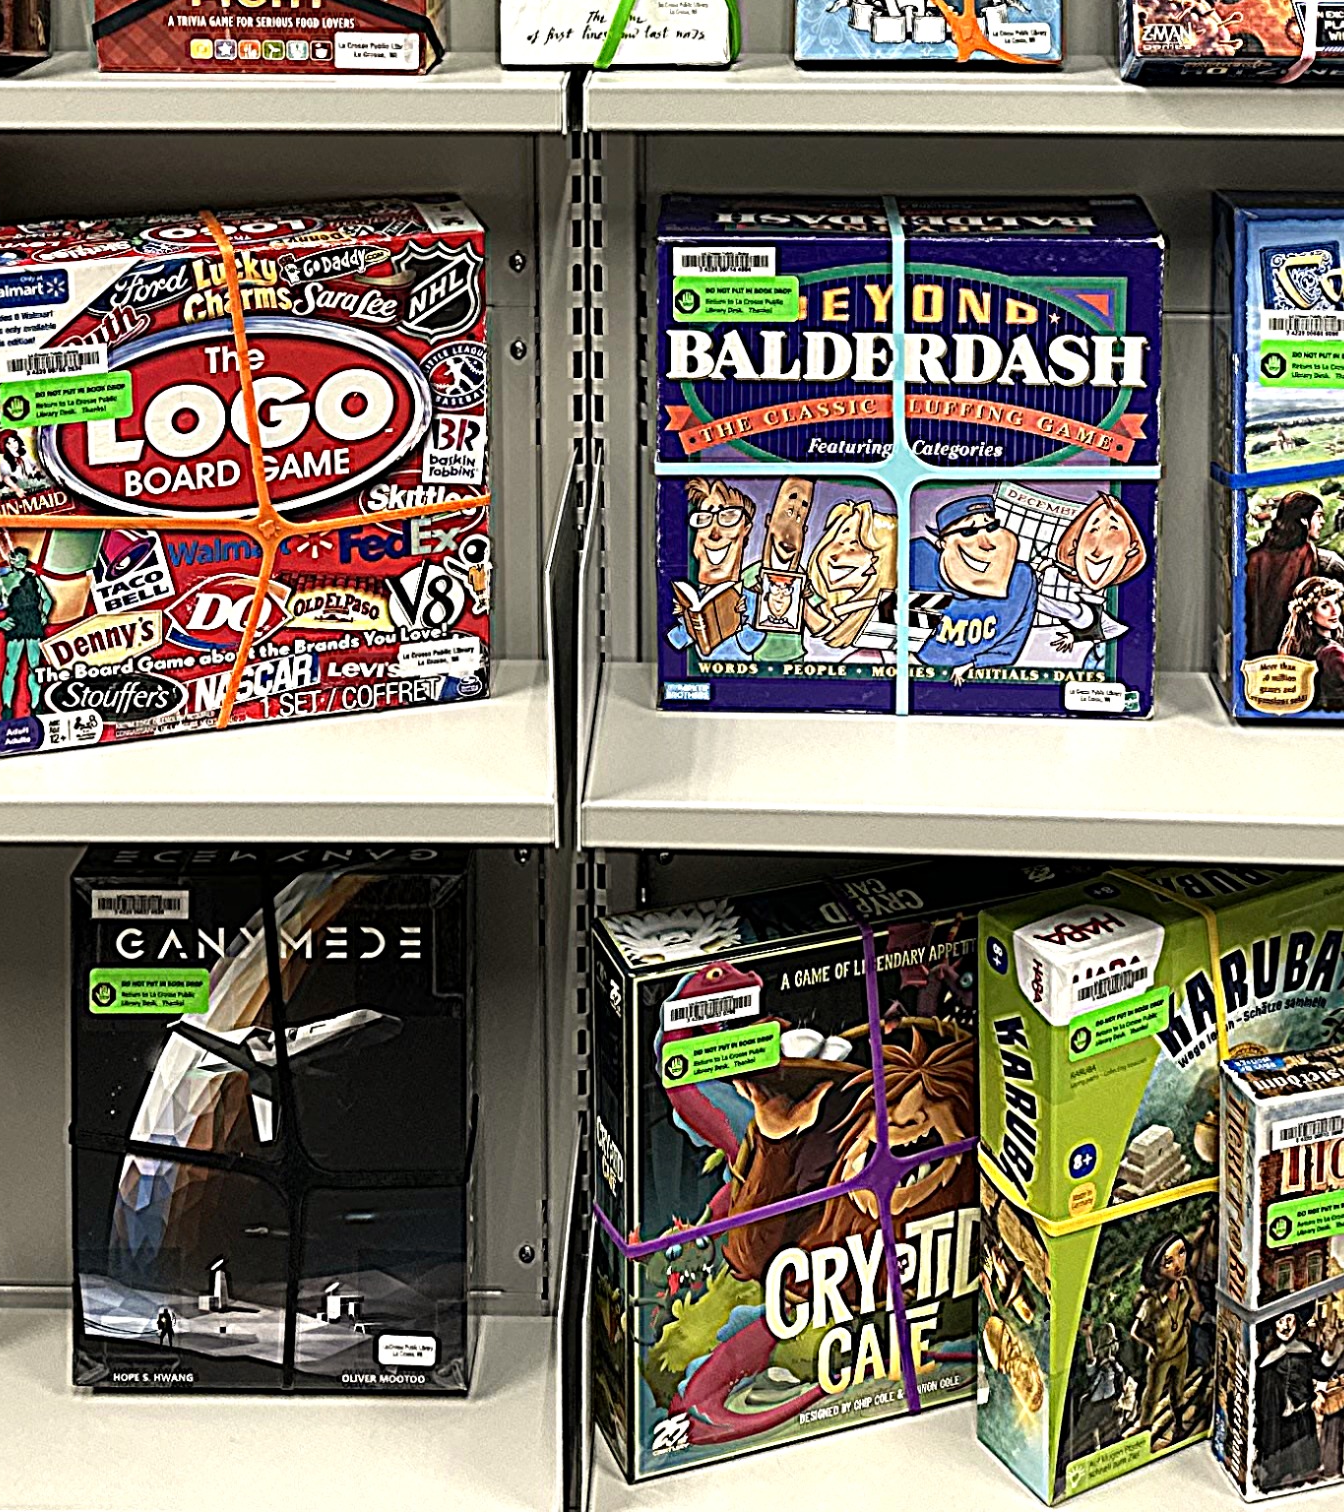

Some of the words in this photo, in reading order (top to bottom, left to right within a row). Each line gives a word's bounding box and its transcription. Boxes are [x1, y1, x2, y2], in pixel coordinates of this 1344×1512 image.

[168, 16, 174, 27] A
[177, 16, 207, 27] TRIVIA
[209, 16, 234, 27] GAME
[236, 17, 254, 27] FOR
[256, 17, 293, 28] SERIOUS
[296, 17, 320, 28] FOOD
[322, 18, 354, 29] LOVERS
[409, 271, 463, 316] NHL
[205, 346, 265, 374] The
[666, 329, 1149, 388] BALDERDASH
[86, 369, 395, 465] LOGO
[700, 417, 752, 444] THE
[763, 398, 878, 426] CLASSIC
[1036, 418, 1114, 451] GAME
[429, 454, 477, 466] baskin
[808, 437, 894, 457] Featuring
[912, 439, 1003, 458] Categories
[125, 460, 241, 496] BOARD
[263, 449, 349, 481] GAME
[339, 520, 459, 564] FedEx
[96, 571, 163, 598] TACO
[104, 584, 169, 613] BELL
[55, 618, 155, 661] Denny's
[35, 667, 68, 683] The
[72, 660, 135, 680] Board
[138, 656, 193, 674] Game
[699, 662, 758, 675] WORDS
[783, 664, 847, 676] PEOPLE
[967, 669, 1038, 681] INITIALS
[1054, 671, 1105, 683] DATES
[62, 677, 169, 714] Stouffer's
[342, 676, 437, 710] COFFRET
[115, 926, 423, 960] GANYMEDE
[781, 973, 791, 990] A
[794, 965, 831, 987] GAME
[835, 959, 850, 980] OF
[113, 1373, 140, 1382] HOPE
[143, 1373, 152, 1382] S.
[154, 1373, 194, 1383] HWANG
[341, 1374, 377, 1383] OLIVER
[379, 1374, 426, 1384] MOOTOO
